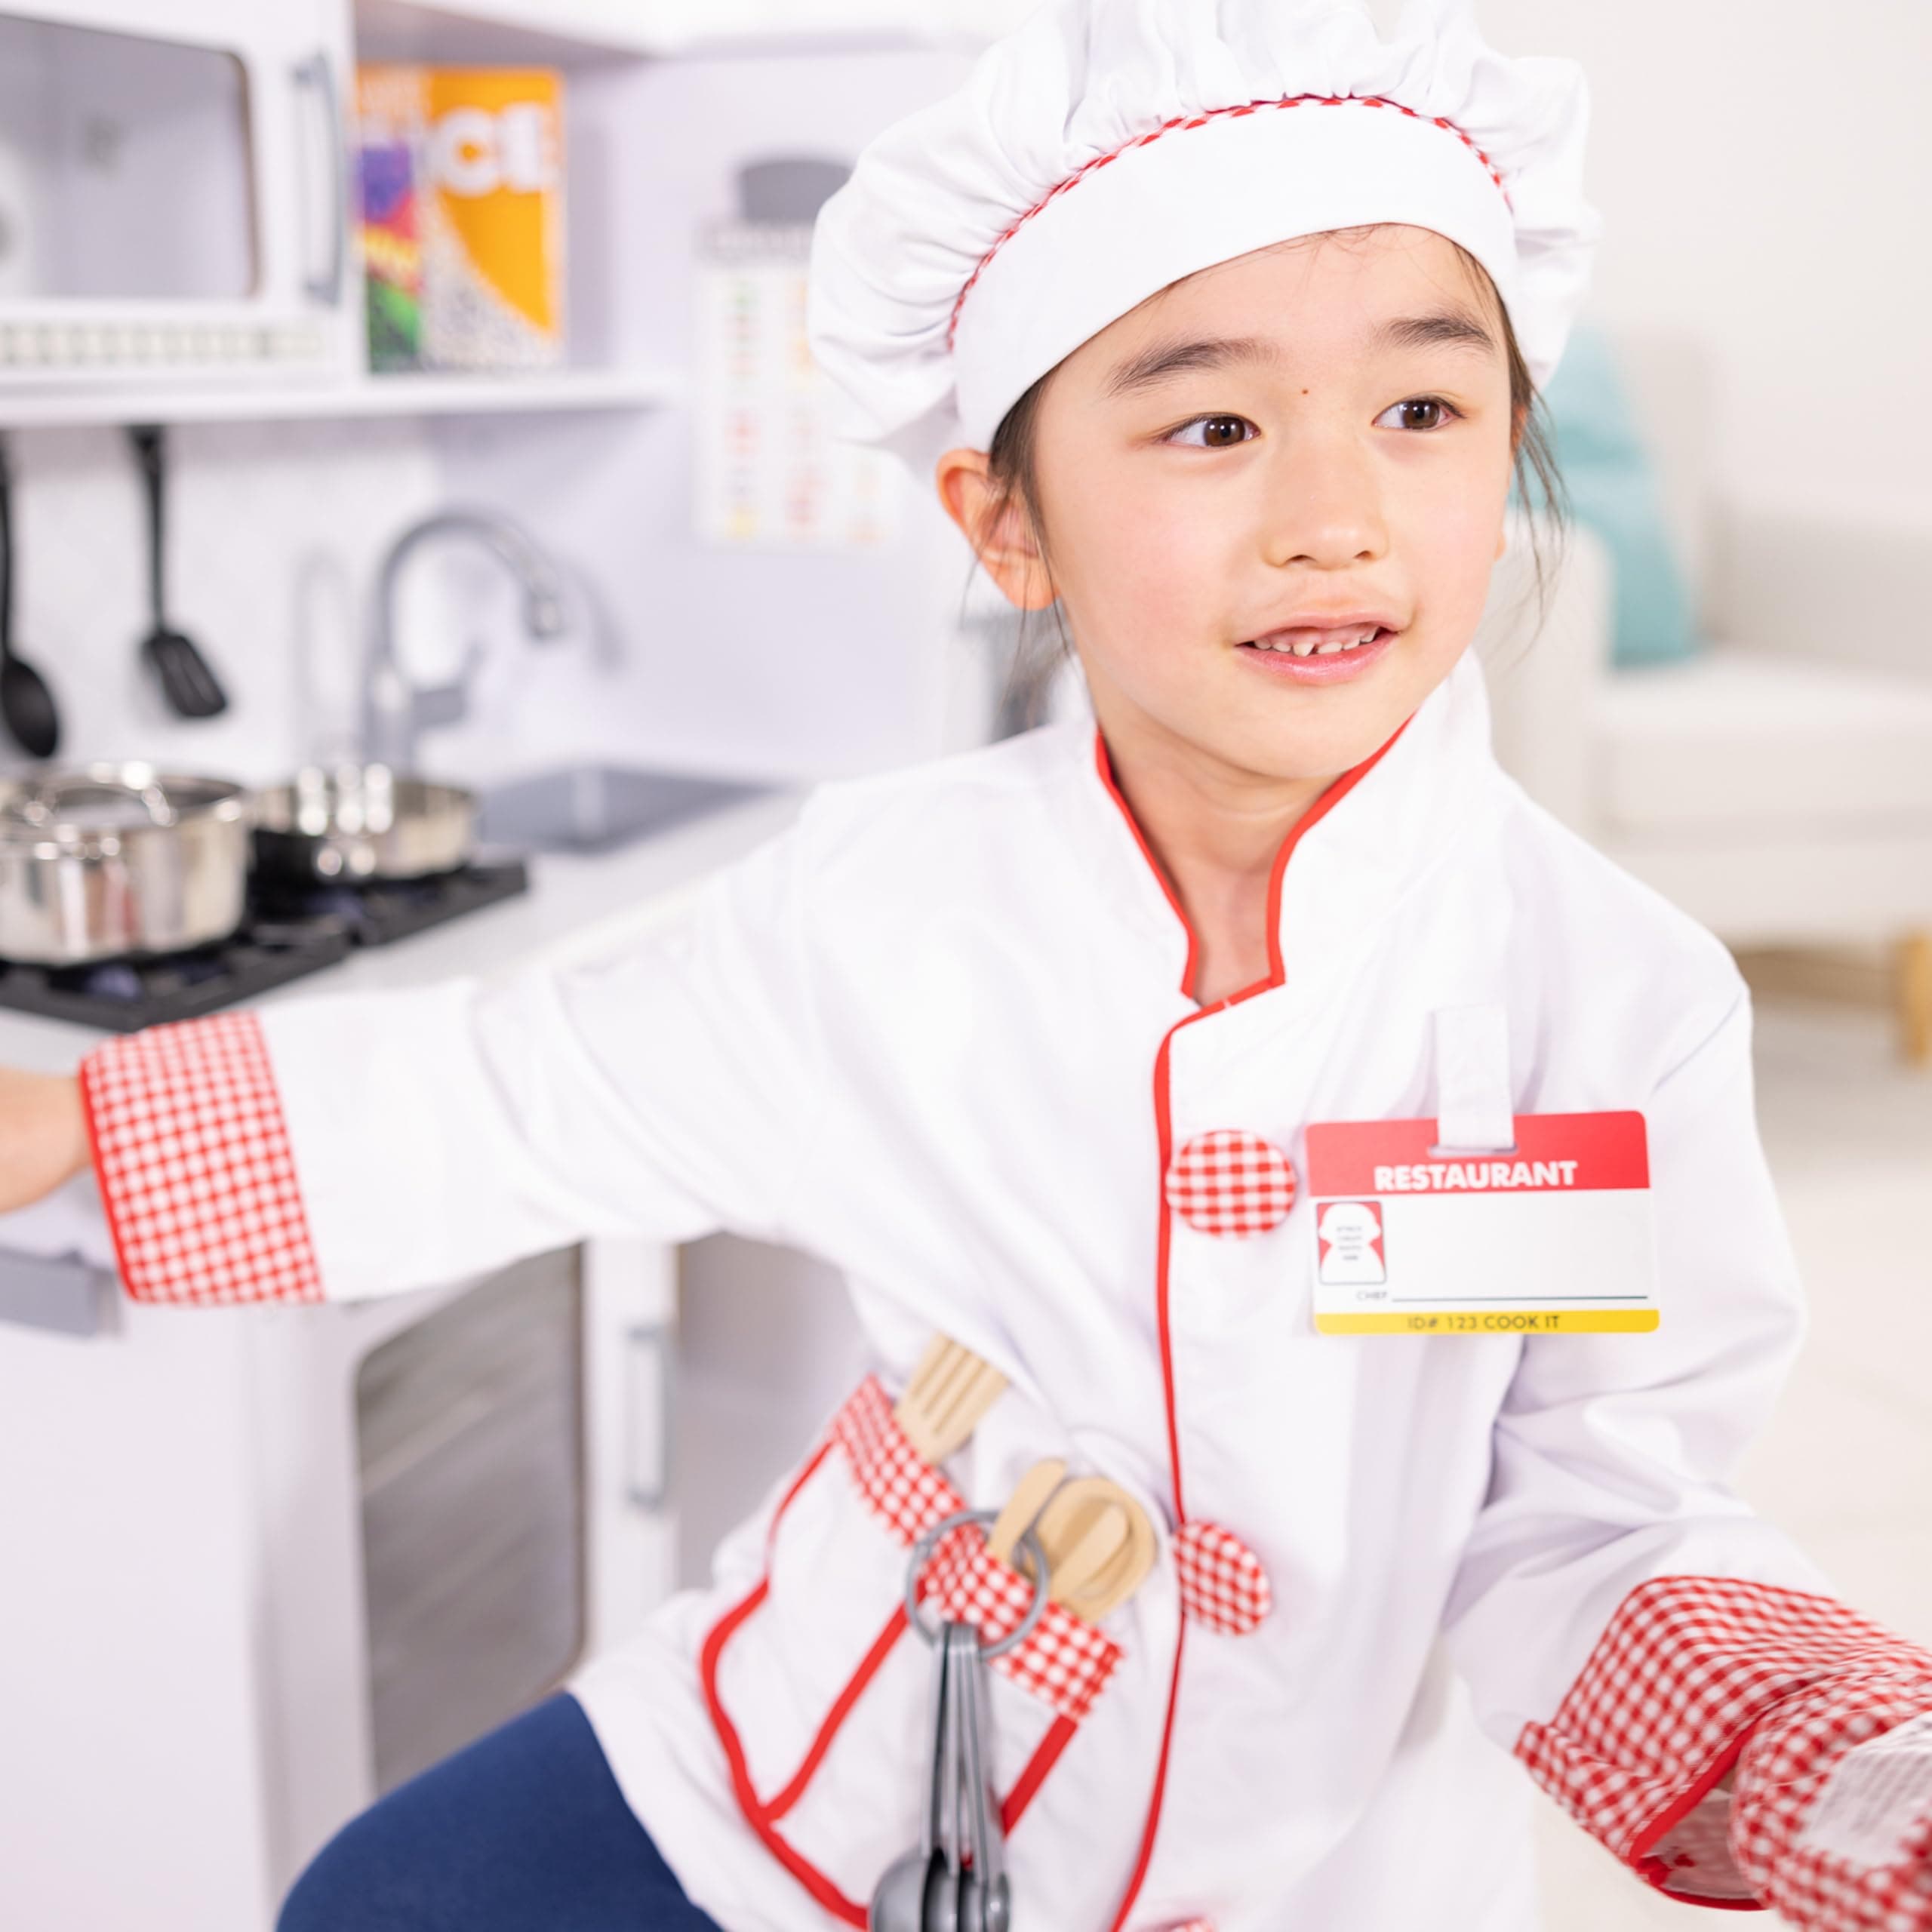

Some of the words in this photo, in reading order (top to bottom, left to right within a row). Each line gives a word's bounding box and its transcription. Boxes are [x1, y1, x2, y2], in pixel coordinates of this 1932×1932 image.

[1374, 1160, 1579, 1191] RESTAURANT
[1355, 1290, 1388, 1300] CHEF
[1407, 1316, 1438, 1330] ID#
[1447, 1316, 1478, 1329] 123
[1484, 1315, 1539, 1329] COOK
[1545, 1315, 1560, 1329] IT
